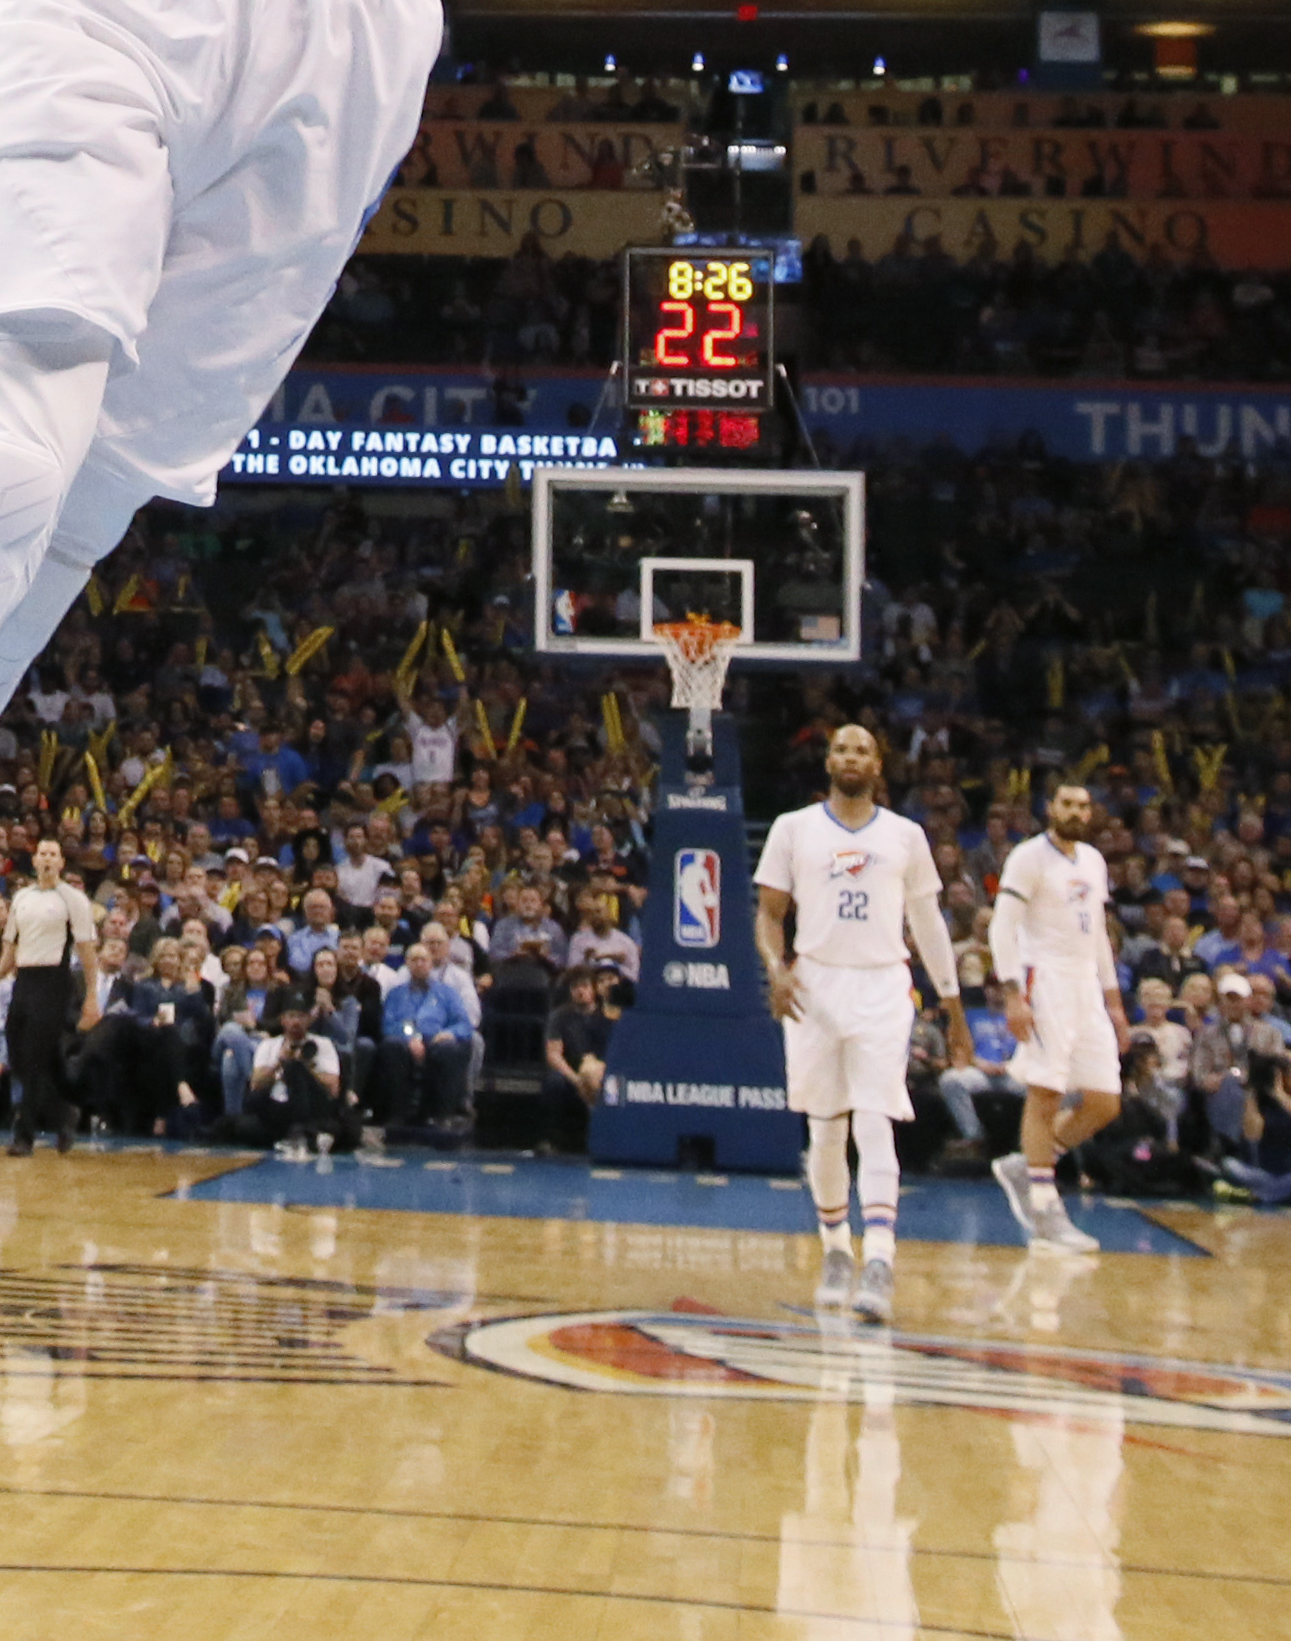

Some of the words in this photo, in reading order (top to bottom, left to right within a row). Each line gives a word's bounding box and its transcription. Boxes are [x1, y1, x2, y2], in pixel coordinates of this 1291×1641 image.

[365, 197, 573, 239] SINO
[907, 207, 1212, 253] CASINO
[669, 261, 753, 302] 8:26
[655, 301, 743, 368] 22
[670, 377, 764, 399] TISSOT
[808, 387, 860, 414] 101
[369, 385, 536, 425] CIT
[288, 430, 343, 452] DAY
[351, 431, 471, 455] FANTASY
[232, 453, 280, 474] THE
[290, 455, 442, 479] OKLAHOMA
[450, 458, 513, 481] CITY
[838, 890, 870, 920] 22
[626, 1079, 664, 1103] NBA
[666, 1082, 736, 1107] LEAGUE
[740, 1086, 787, 1110] PASS
